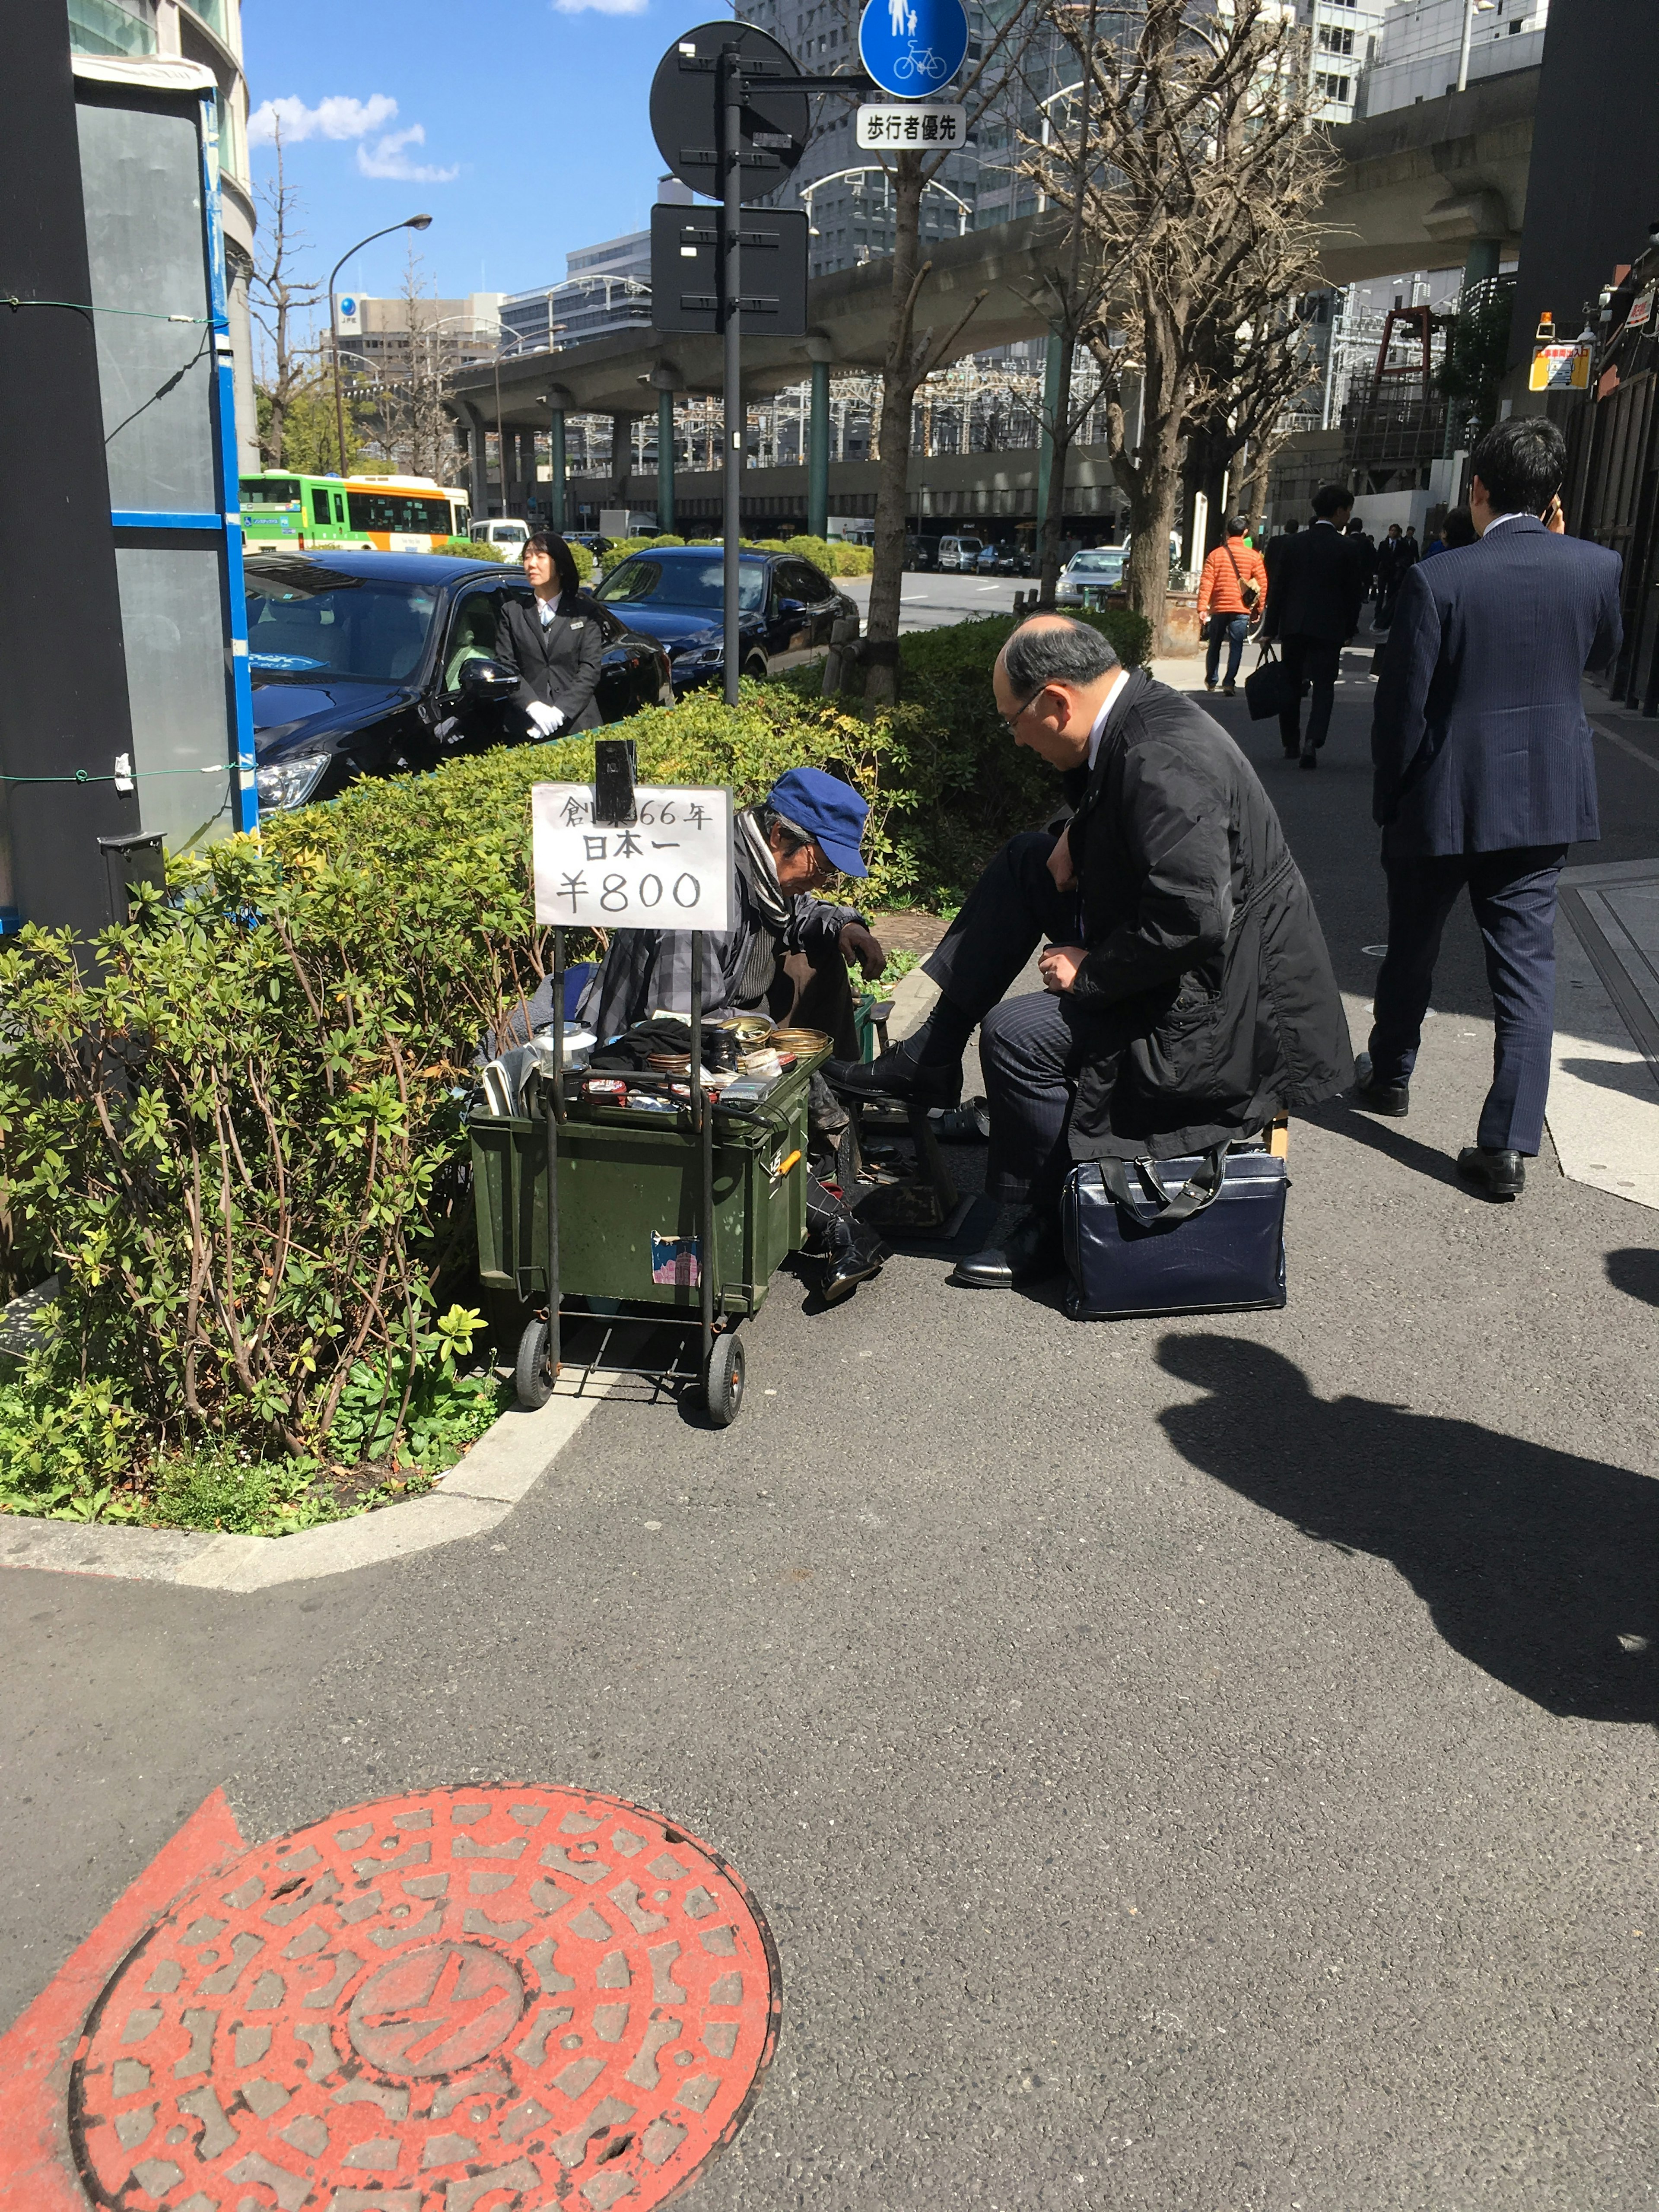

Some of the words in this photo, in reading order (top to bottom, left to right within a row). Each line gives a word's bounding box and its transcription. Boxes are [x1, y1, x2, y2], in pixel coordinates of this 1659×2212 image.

[868, 114, 956, 140] 歩行者優先
[1536, 348, 1589, 359] 工事車両出入口
[559, 796, 713, 830] 創66年
[583, 830, 680, 861] 日本一
[556, 870, 701, 914] ¥800
